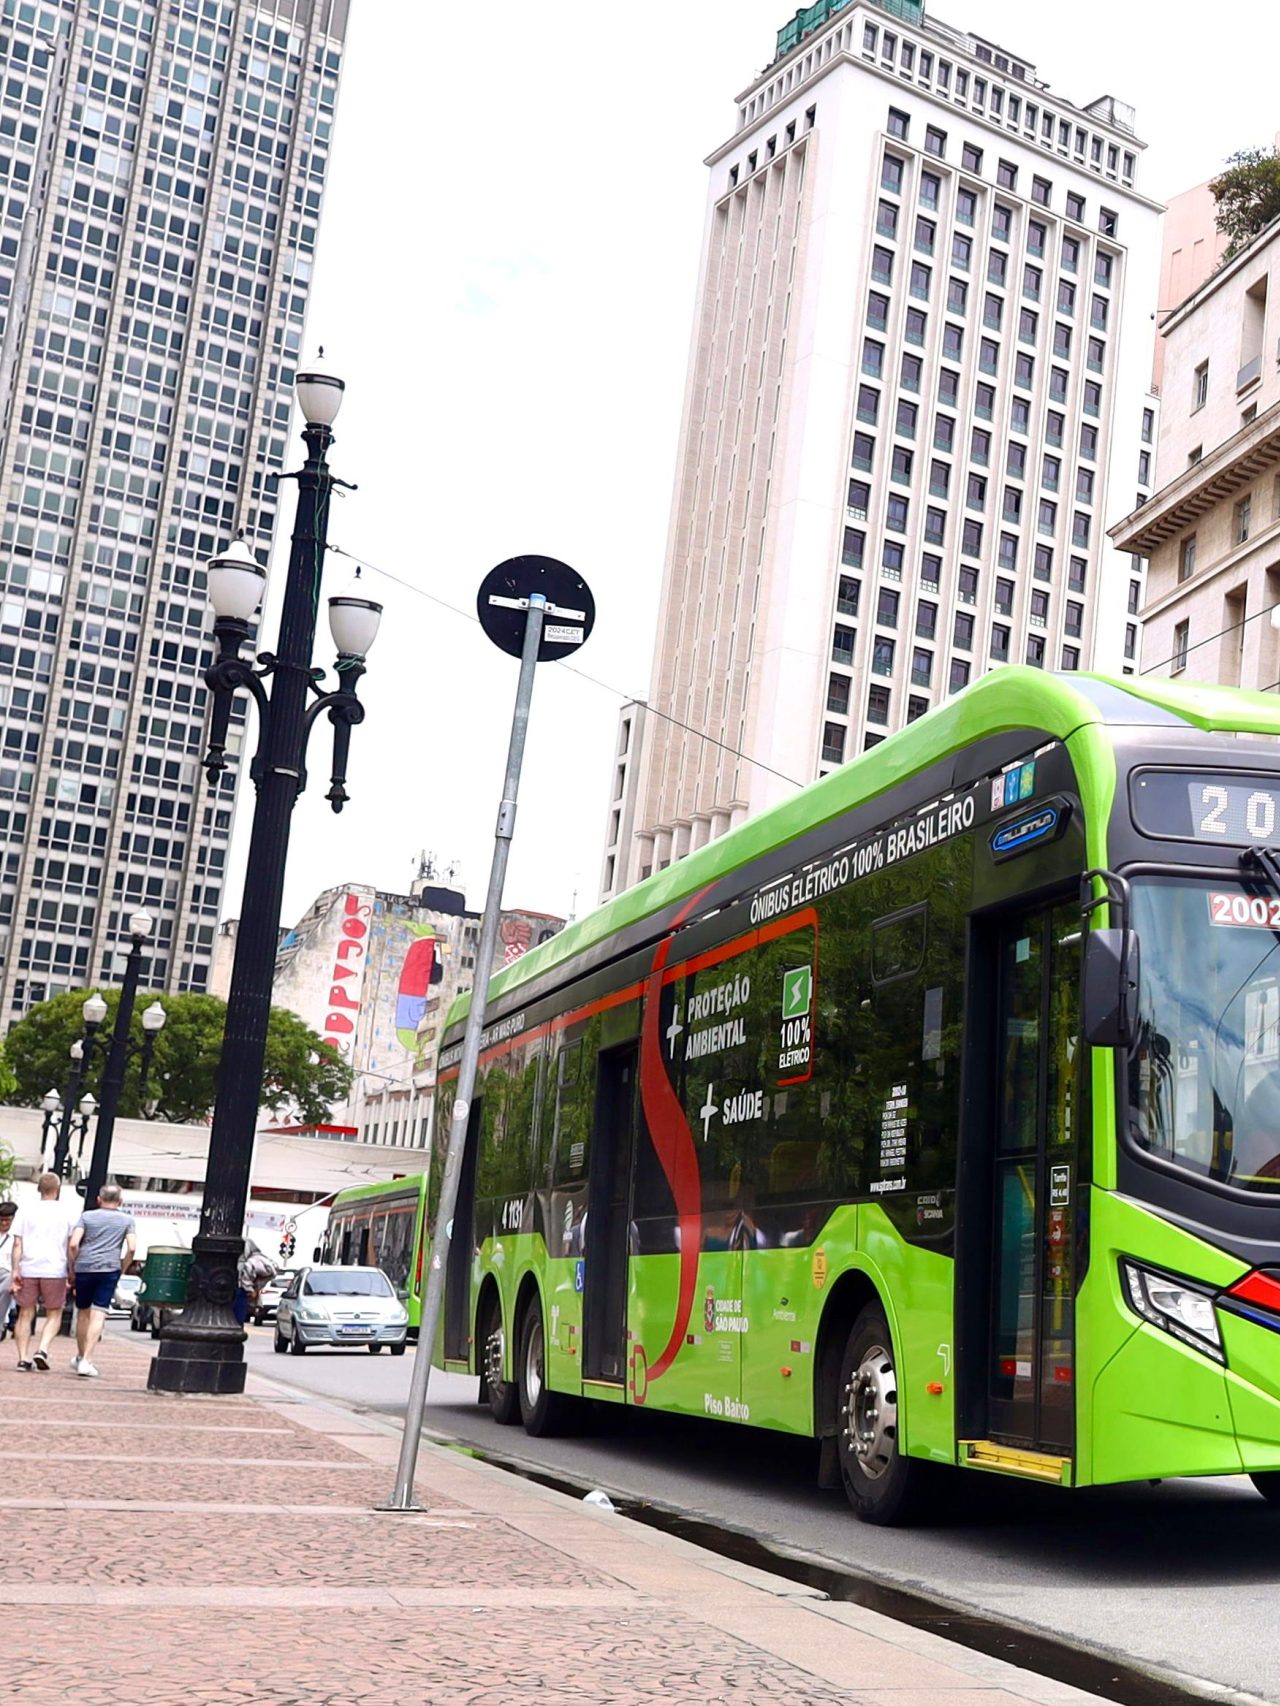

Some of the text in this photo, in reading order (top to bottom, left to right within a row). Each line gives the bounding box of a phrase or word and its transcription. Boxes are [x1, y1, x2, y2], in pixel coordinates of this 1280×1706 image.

[750, 796, 975, 925] ÔNIBUS ELÉTRICO 100% BRASILEIRO
[688, 973, 750, 1023] PROTEÇÃO
[685, 1017, 746, 1061] AMBIENTAL
[780, 1016, 810, 1048] 100%
[779, 1047, 809, 1069] ELÉTRICO
[723, 1088, 763, 1125] SAÚDE
[133, 1210, 186, 1218] INTERDITADA
[145, 1203, 190, 1212] ESPORTIVO
[715, 1313, 749, 1333] SÃO PAULO
[704, 1393, 750, 1420] Piso Baixo
